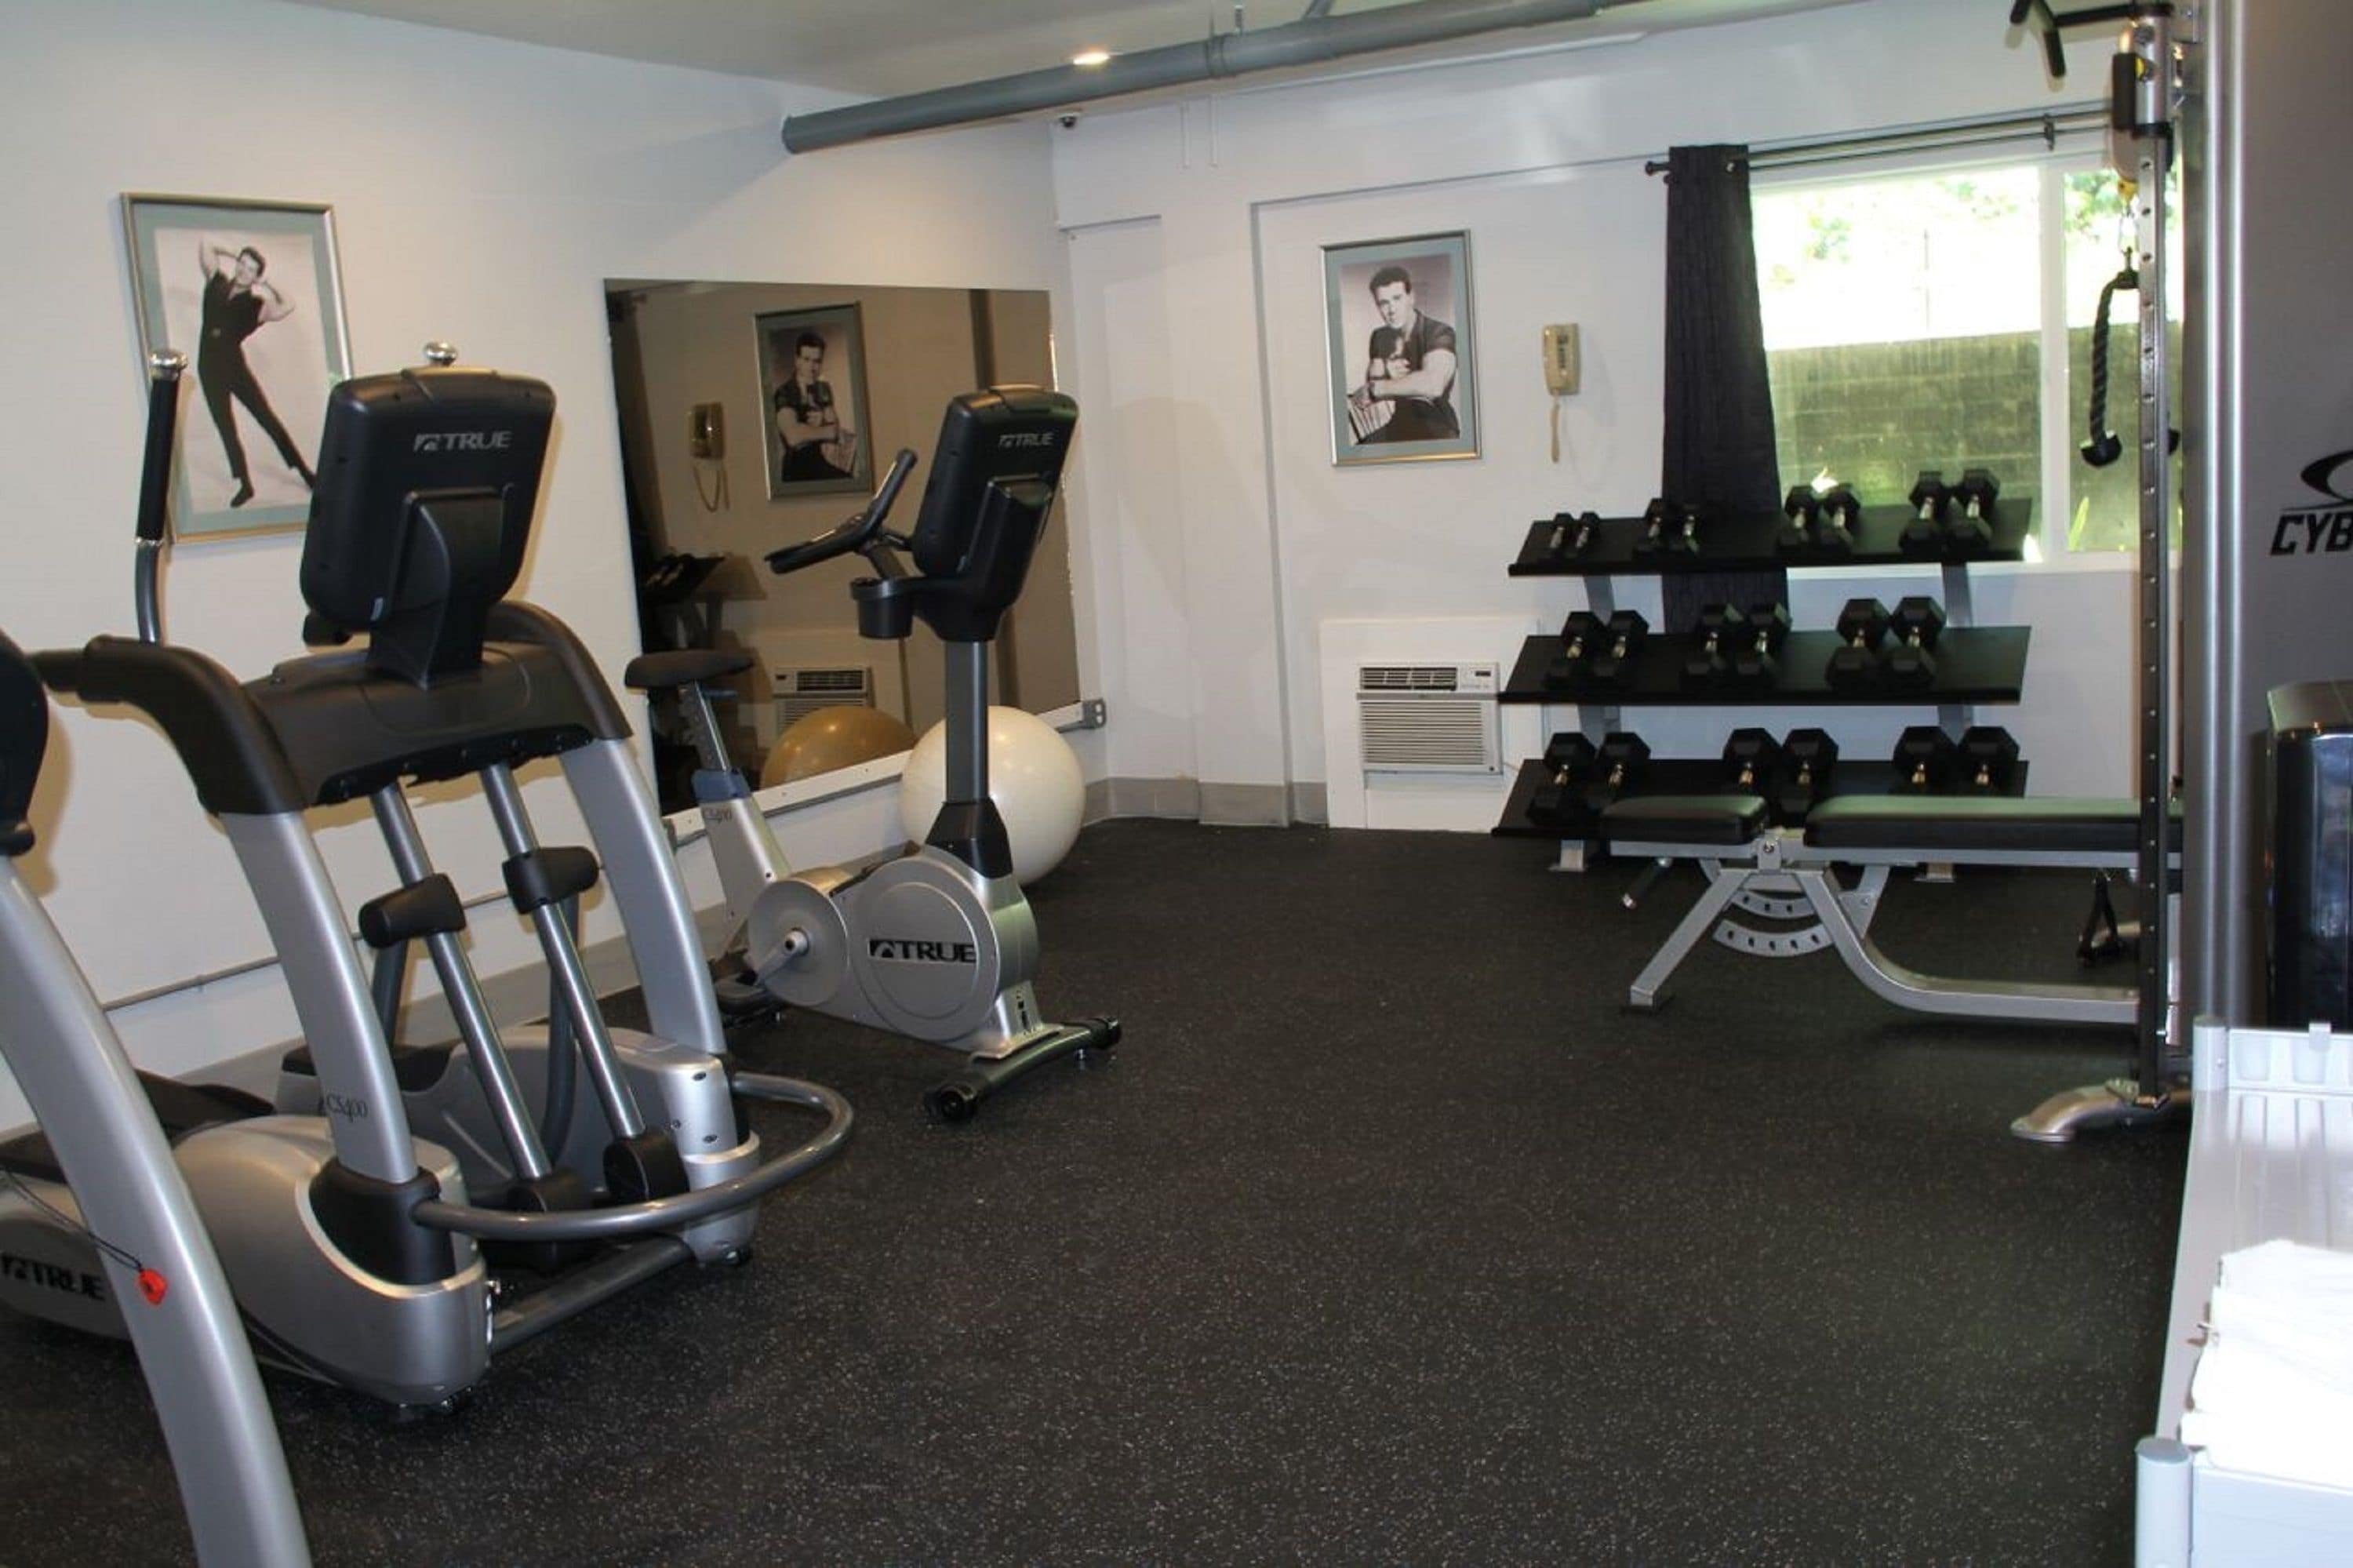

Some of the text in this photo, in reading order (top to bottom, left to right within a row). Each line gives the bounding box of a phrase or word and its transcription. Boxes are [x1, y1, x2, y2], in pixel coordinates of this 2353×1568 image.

[442, 431, 511, 451] TRUE
[894, 940, 977, 963] TRUE
[31, 1260, 106, 1302] TRUE
